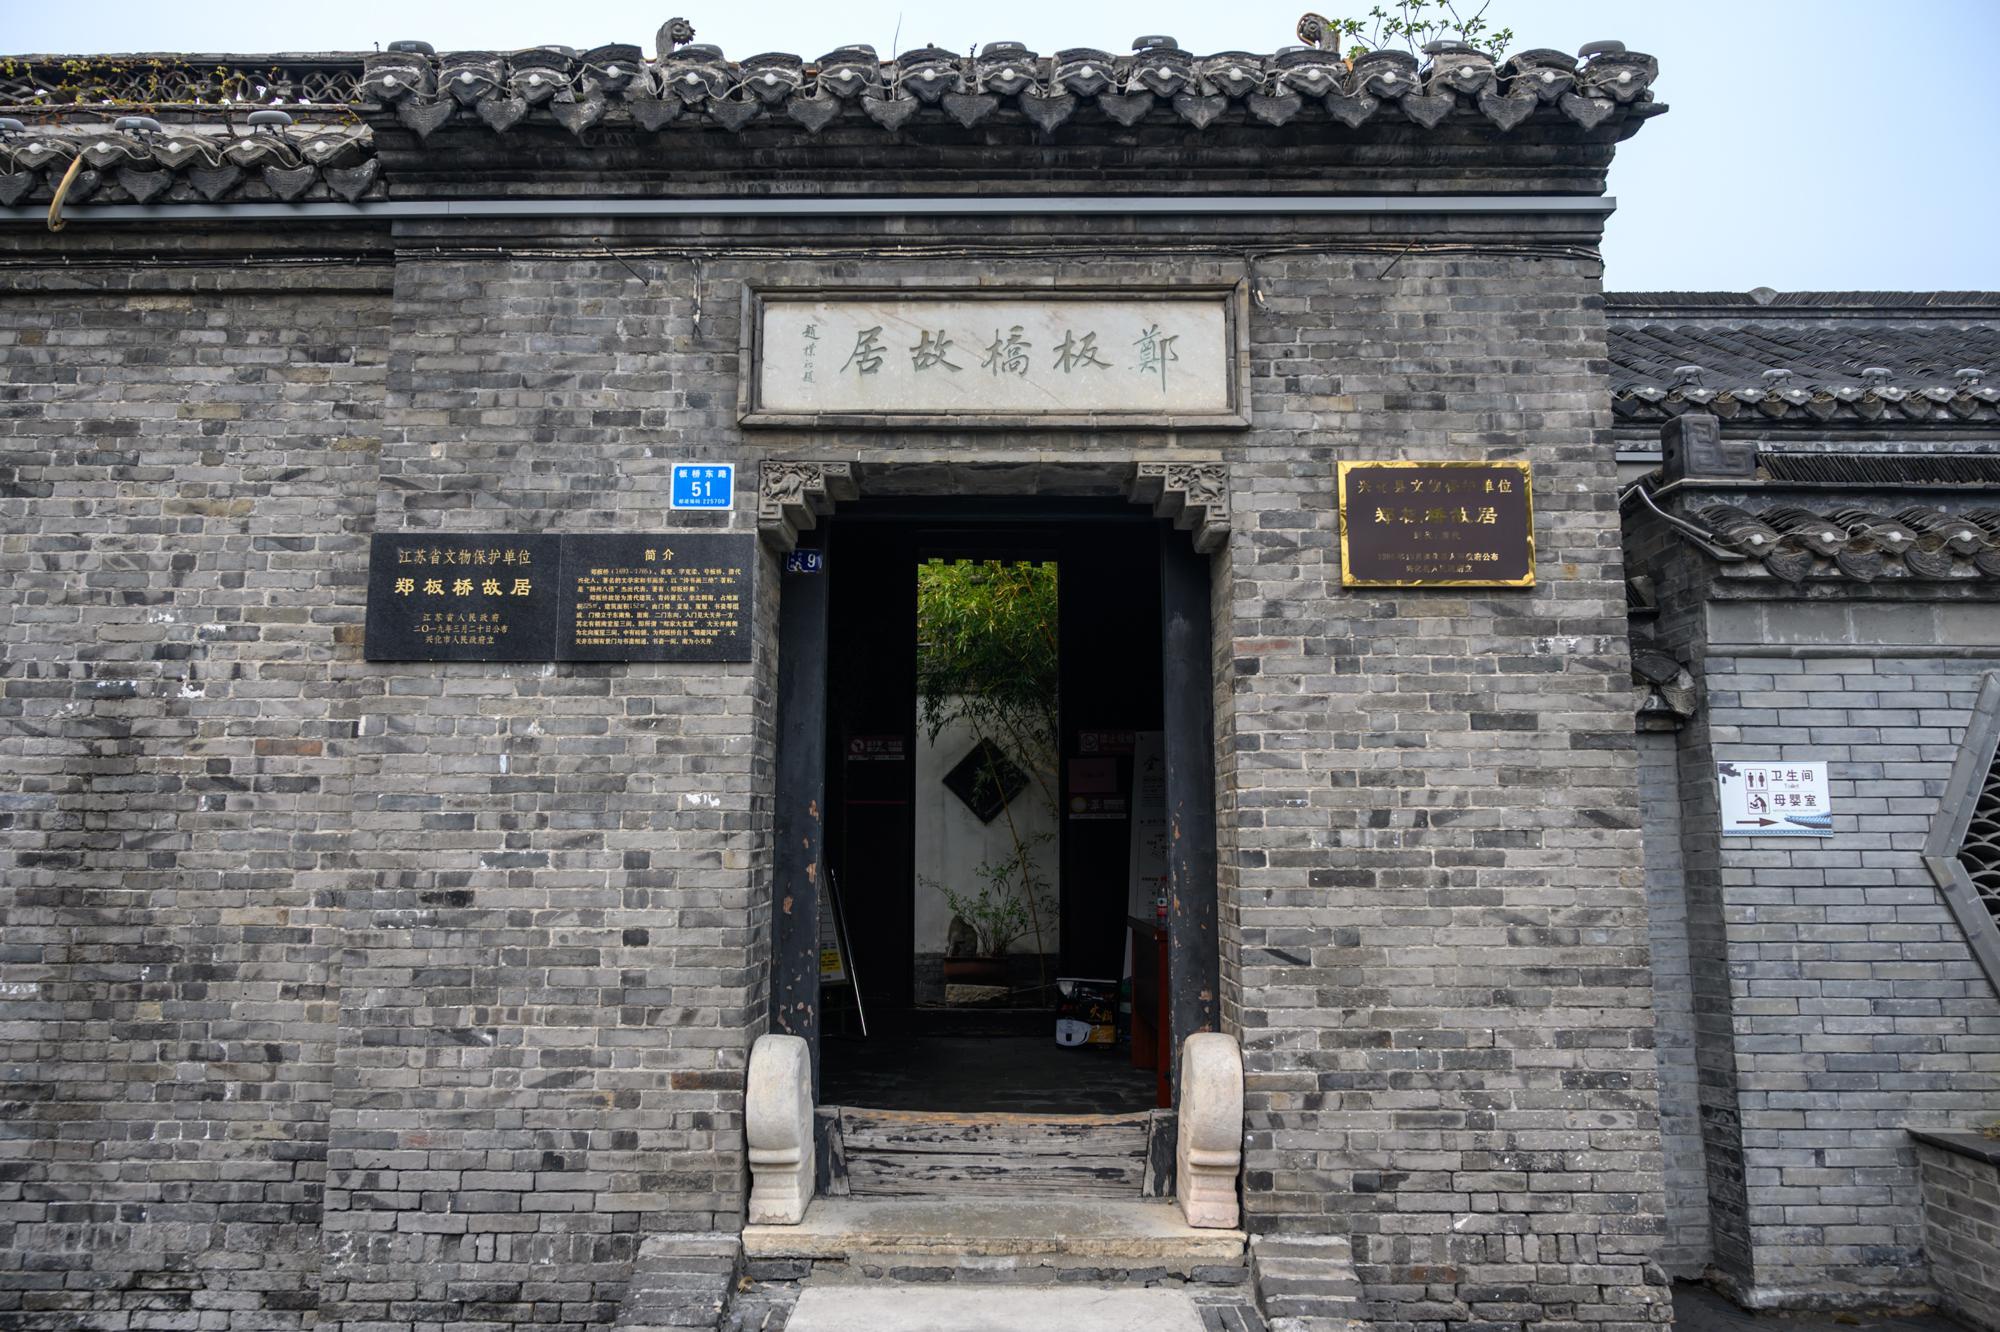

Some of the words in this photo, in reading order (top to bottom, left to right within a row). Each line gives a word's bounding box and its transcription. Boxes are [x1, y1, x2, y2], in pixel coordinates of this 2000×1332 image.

[841, 324, 1180, 393] 鄭板橋故居
[678, 469, 727, 478] 板桥东路
[691, 481, 711, 497] 51
[398, 548, 532, 565] 江苏省文物保护单位
[644, 549, 674, 562] 简介
[394, 578, 532, 596] 郑板桥故居
[1771, 769, 1813, 782] 卫生间
[1774, 794, 1816, 807] 母婴室
